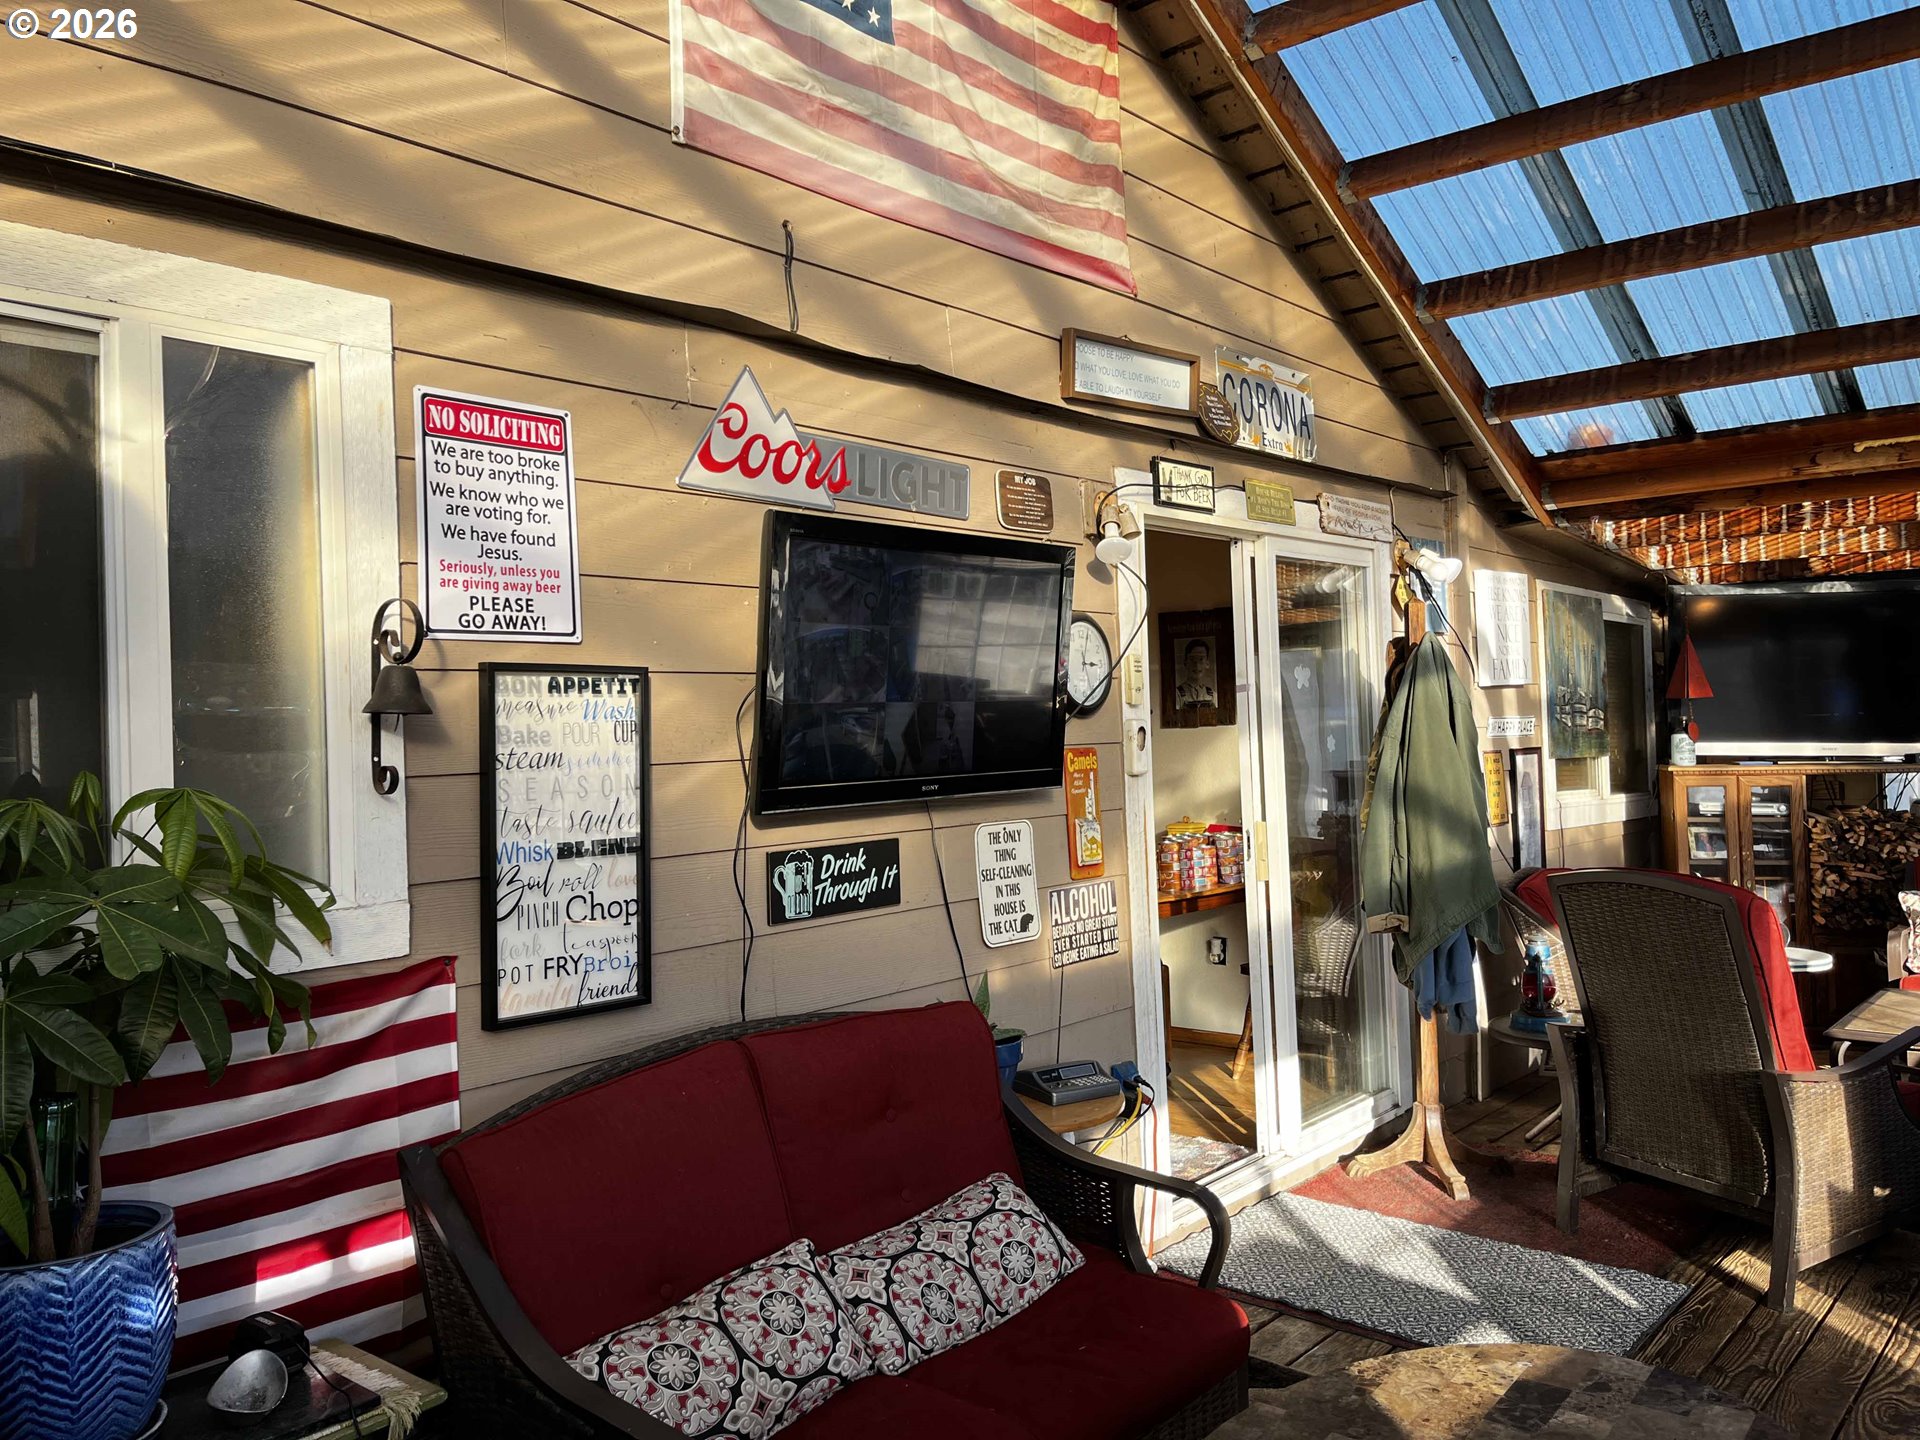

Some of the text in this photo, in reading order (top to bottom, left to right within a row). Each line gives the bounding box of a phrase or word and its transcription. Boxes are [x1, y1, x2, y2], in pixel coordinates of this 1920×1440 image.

[1076, 344, 1134, 362] HOOSE TO BE HAPPY
[1081, 363, 1097, 373] WHAT
[1099, 366, 1110, 376] YOU
[1129, 371, 1143, 382] LOVE
[1144, 374, 1159, 384] WHAT
[1161, 376, 1172, 387] YOU
[1172, 379, 1180, 388] DO
[1080, 381, 1094, 390] ABLE
[1096, 382, 1104, 392] TO
[1105, 384, 1124, 396] LAUGH
[1126, 389, 1132, 397] AT
[1223, 373, 1310, 440] CORONA
[428, 405, 560, 447] NO SOLICITING
[697, 402, 852, 494] Coors
[1263, 432, 1283, 451] Extra
[432, 440, 560, 471] We are too broke
[434, 461, 558, 490] to buy anything.
[856, 452, 966, 512] LIGHT
[1024, 478, 1036, 486] JOB
[1173, 466, 1192, 485] THANK
[430, 481, 564, 509] We know who we
[446, 503, 551, 524] are voting for.
[442, 524, 556, 547] We have found
[478, 544, 522, 561] Jesus.
[440, 560, 560, 580] Seriously, unless you
[440, 577, 561, 595] are giving away beer
[470, 596, 534, 613] PLEASE
[459, 614, 546, 630] GO AWAY!
[1497, 624, 1521, 642] NICE
[1493, 658, 1529, 680] FAMILY
[496, 676, 640, 697] BON APPETIT
[496, 698, 635, 725] measure Wash
[496, 720, 637, 748] Bake POUR CUP
[496, 748, 565, 770] steam
[1067, 752, 1097, 772] Camels
[499, 774, 636, 802] SEASON
[496, 805, 560, 840] taste
[988, 829, 1021, 845] THE ONLY
[496, 837, 641, 865] Whisk BLEND
[994, 848, 1016, 862] THING
[821, 848, 866, 880] Drink
[981, 864, 1032, 882] SELF-CLEANING
[497, 858, 637, 922] Boil roll love
[815, 864, 897, 906] Through It
[996, 883, 1021, 898] IN THIS
[518, 891, 639, 930] PINCH Chop
[994, 900, 1026, 916] HOUSE IS
[1051, 882, 1116, 925] ALCOHOL
[989, 919, 1018, 936] THE CAT
[1053, 914, 1117, 939] BECAUSE NO GREAT STORY
[1054, 927, 1118, 953] EVER STARTED WITH
[1055, 940, 1119, 967] SOMEONE EATING A SALAD
[498, 951, 638, 987] POT FRY Broi
